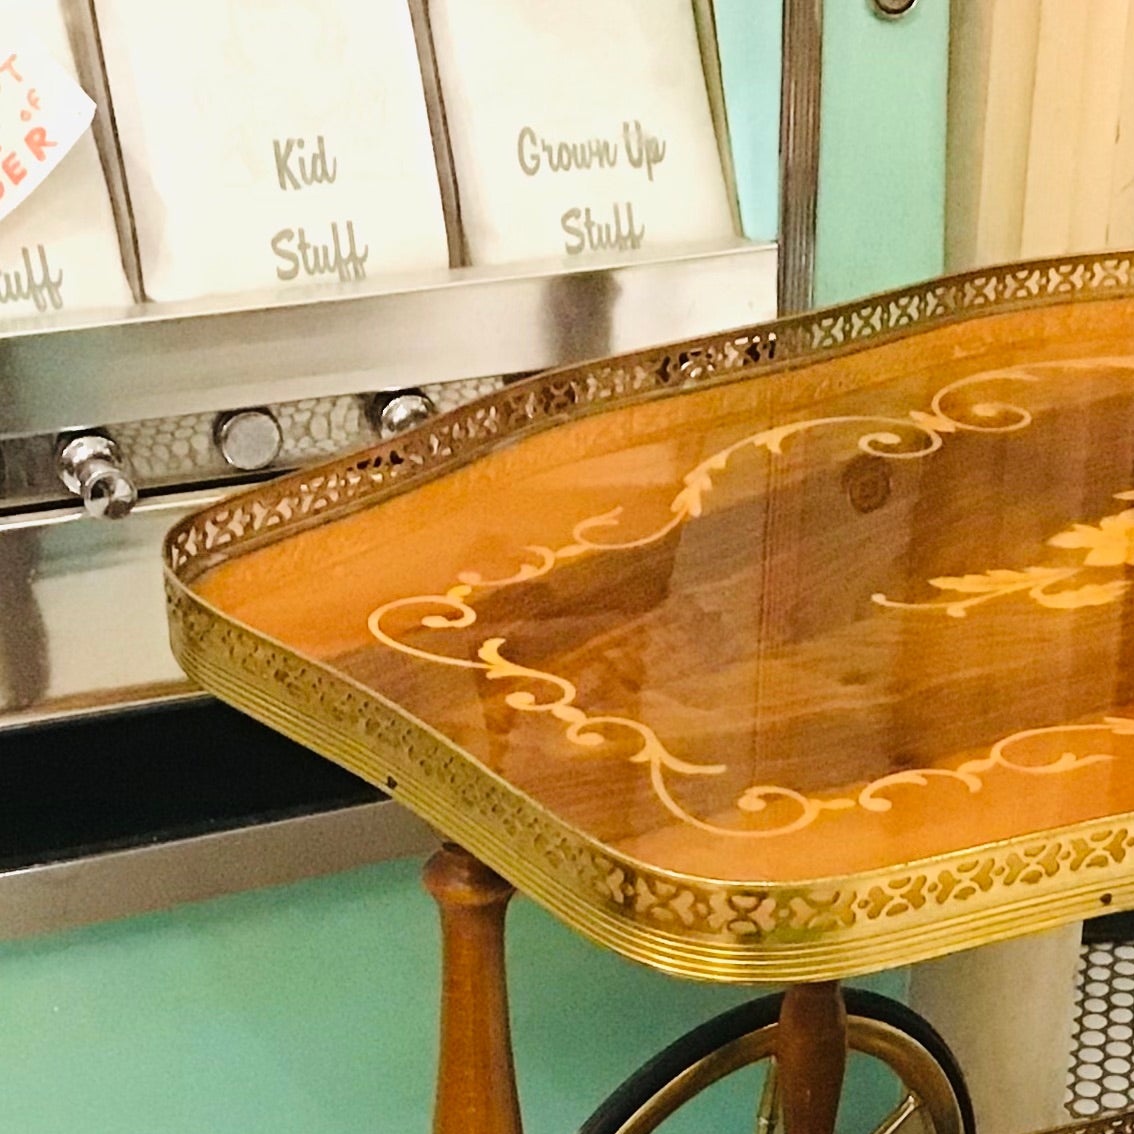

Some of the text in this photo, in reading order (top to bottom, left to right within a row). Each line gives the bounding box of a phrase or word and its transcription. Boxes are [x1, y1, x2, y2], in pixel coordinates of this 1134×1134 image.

[273, 135, 337, 191] Kid
[517, 119, 667, 182] Grown Up
[270, 220, 369, 282] Stuff
[560, 202, 646, 256] Stuff
[0, 244, 63, 312] uff
